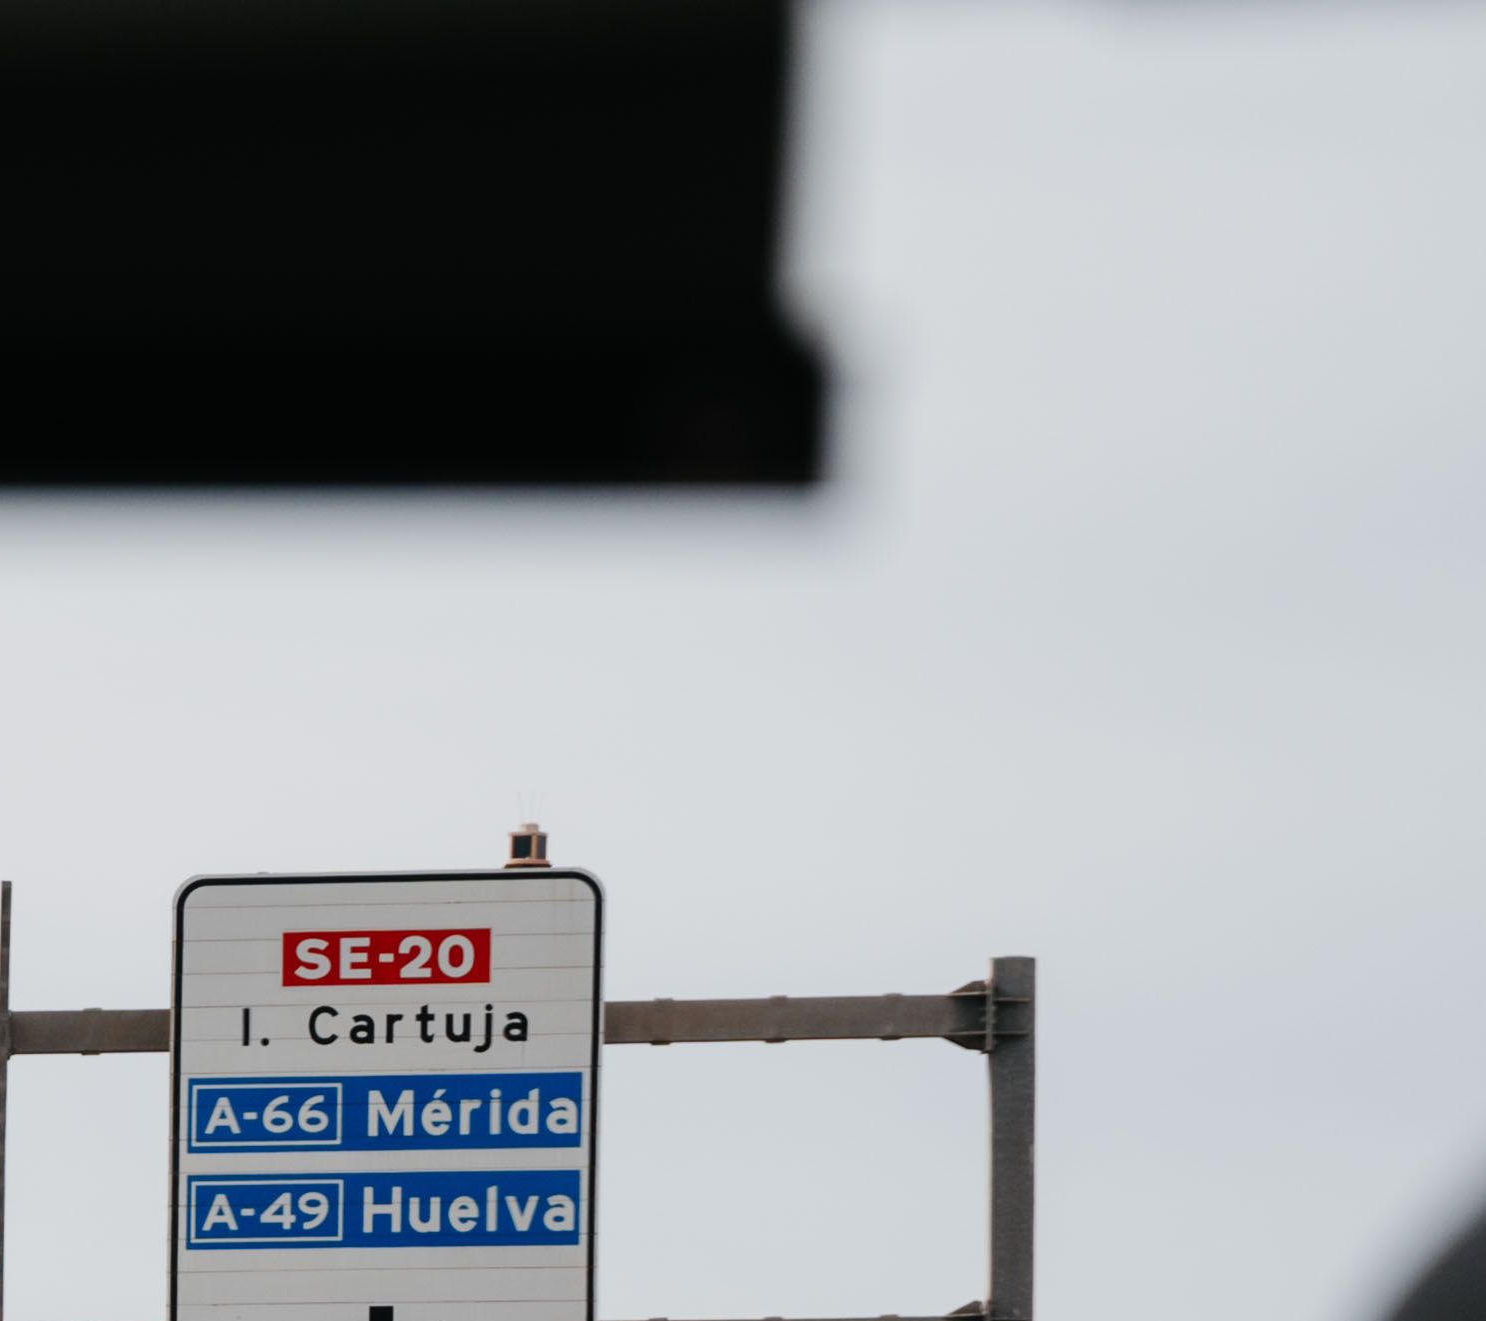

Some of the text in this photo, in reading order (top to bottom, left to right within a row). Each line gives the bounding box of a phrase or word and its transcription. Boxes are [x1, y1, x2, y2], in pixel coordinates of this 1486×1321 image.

[293, 934, 476, 980] SE-20
[242, 1004, 529, 1053] I. Cartuja
[203, 1087, 579, 1138] A-66 Mérida
[201, 1184, 577, 1234] A-49 Huelva
